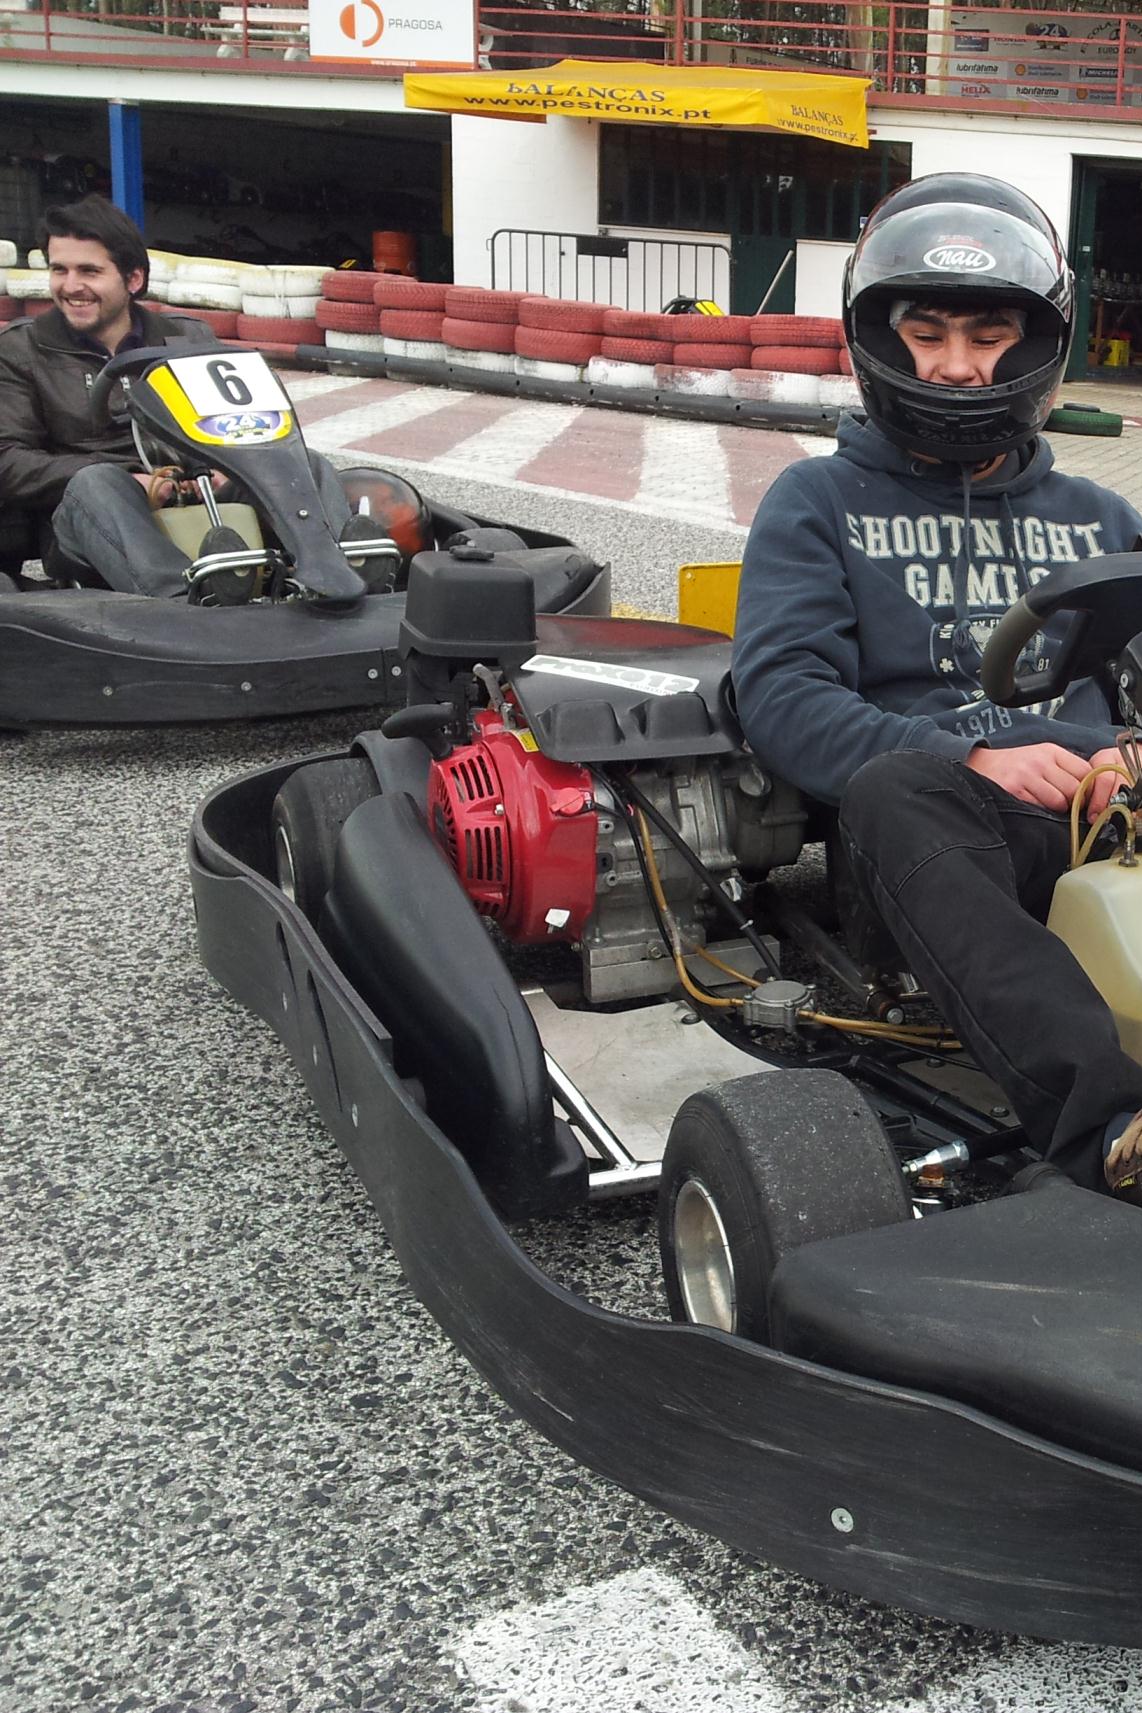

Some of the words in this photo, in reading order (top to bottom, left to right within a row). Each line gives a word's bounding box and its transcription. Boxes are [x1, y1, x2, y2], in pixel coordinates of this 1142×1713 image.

[388, 18, 443, 31] PRAGOSA
[463, 96, 712, 120] www.pestronix.pt
[790, 104, 844, 126] BALANÇAS
[206, 359, 253, 406] 6
[955, 705, 1013, 739] 1978
